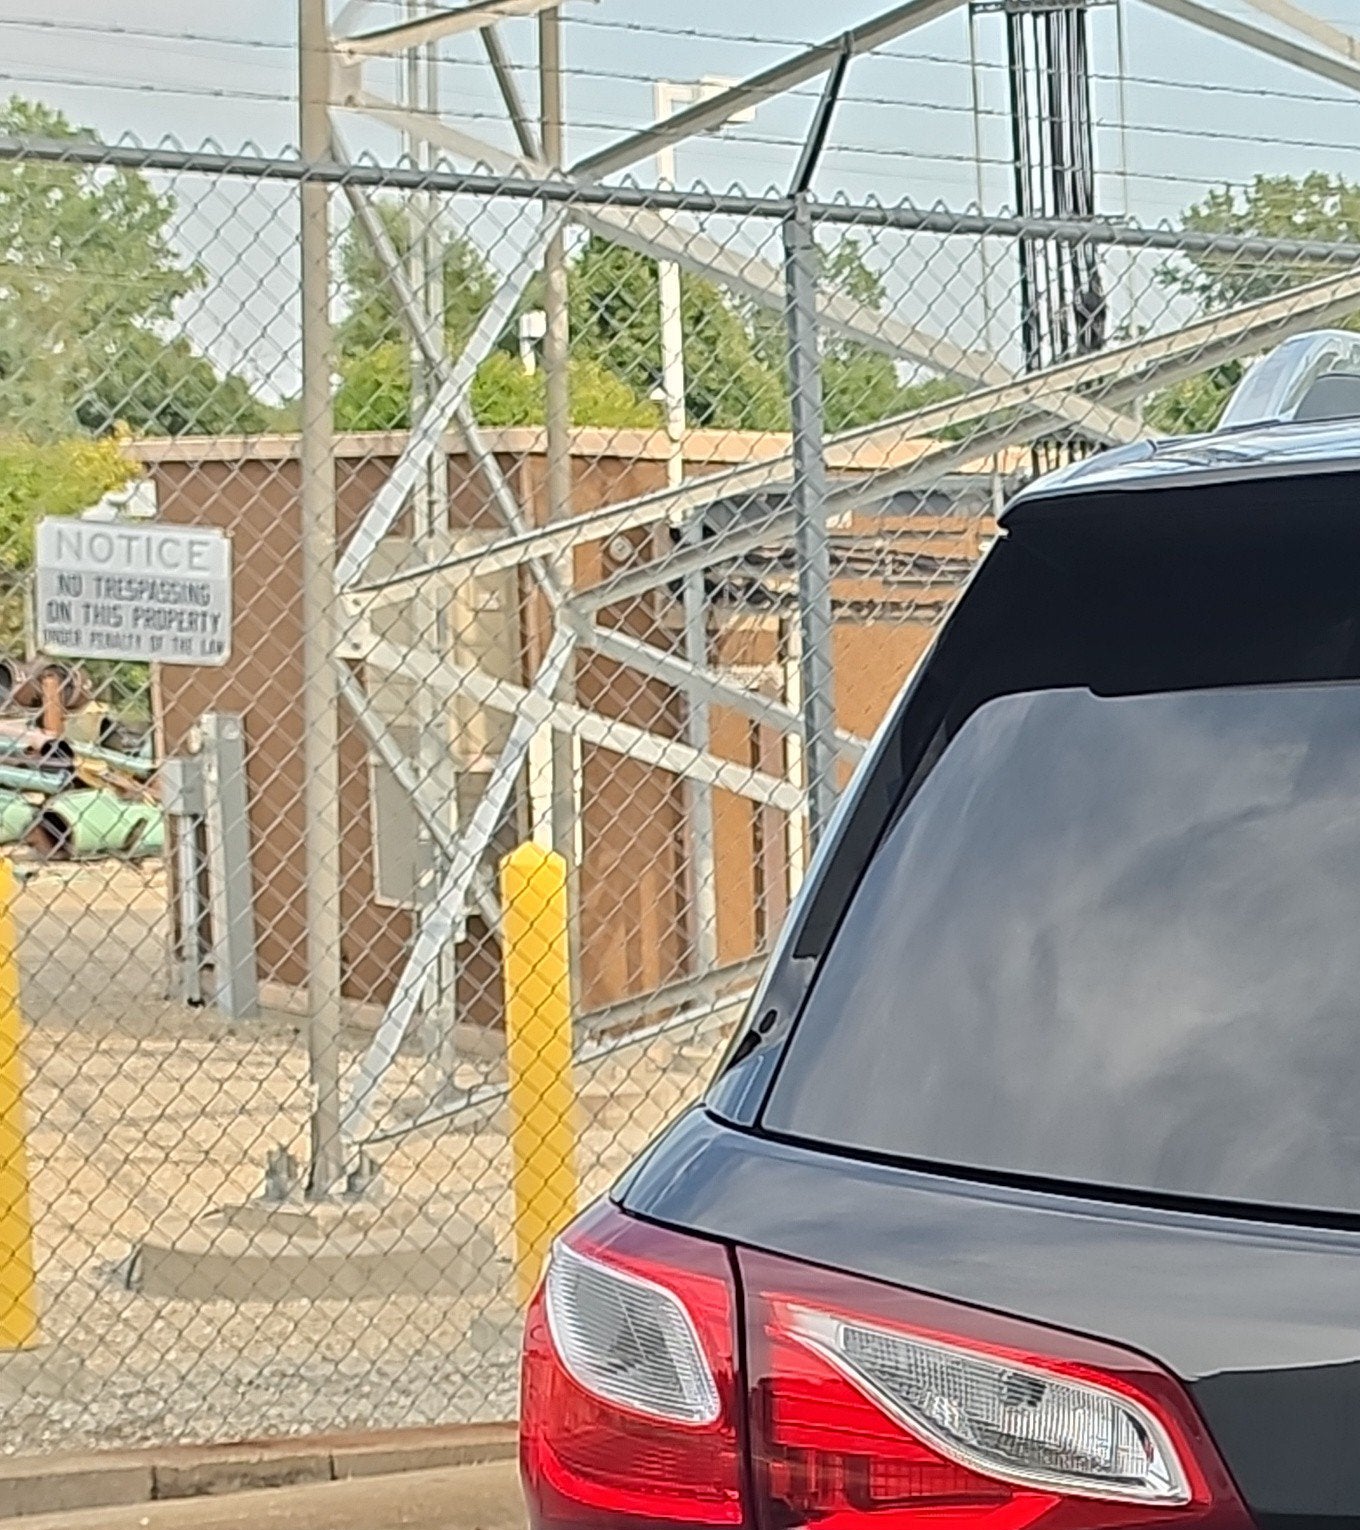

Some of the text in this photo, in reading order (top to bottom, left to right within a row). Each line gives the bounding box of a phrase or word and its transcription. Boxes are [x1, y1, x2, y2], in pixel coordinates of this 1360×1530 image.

[57, 530, 210, 571] NOTICE
[58, 574, 211, 607] NO TRESPASSING
[47, 600, 221, 634] ON THIS PROPERTY
[201, 639, 225, 655] LAW
